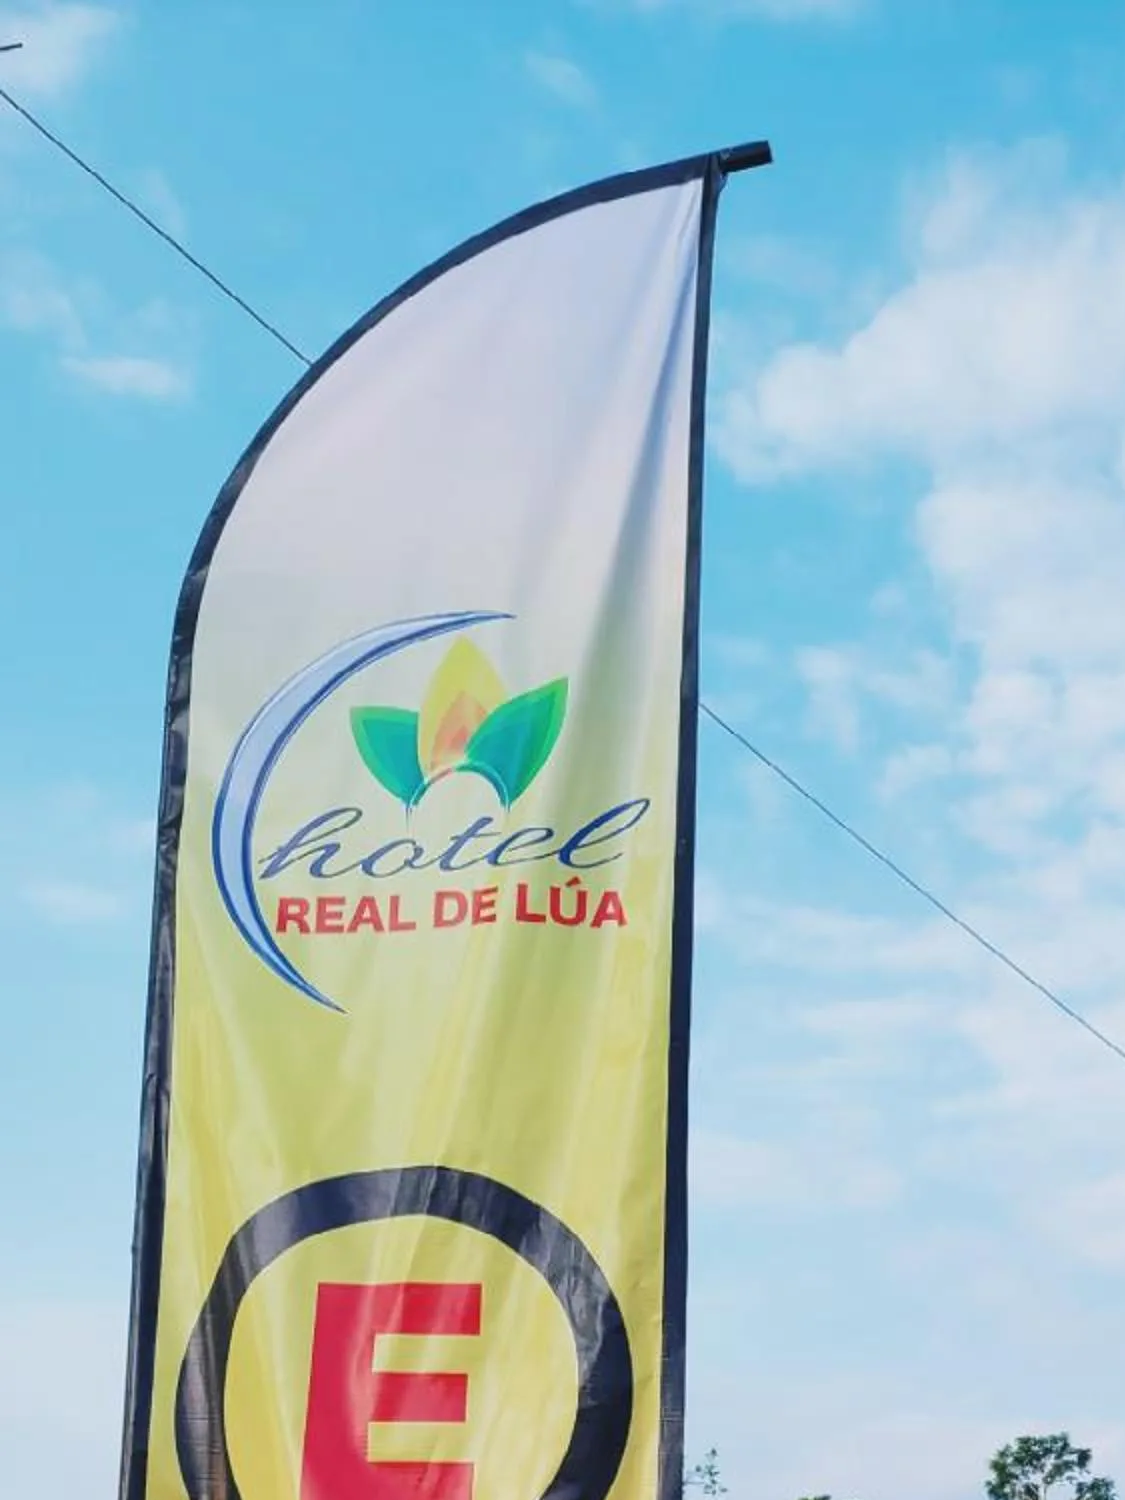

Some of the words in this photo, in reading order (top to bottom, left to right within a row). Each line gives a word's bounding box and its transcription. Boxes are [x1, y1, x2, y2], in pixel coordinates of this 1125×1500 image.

[257, 798, 651, 880] hotel
[275, 895, 417, 934] REAL
[433, 885, 498, 928] DE
[515, 876, 628, 928] LÚA
